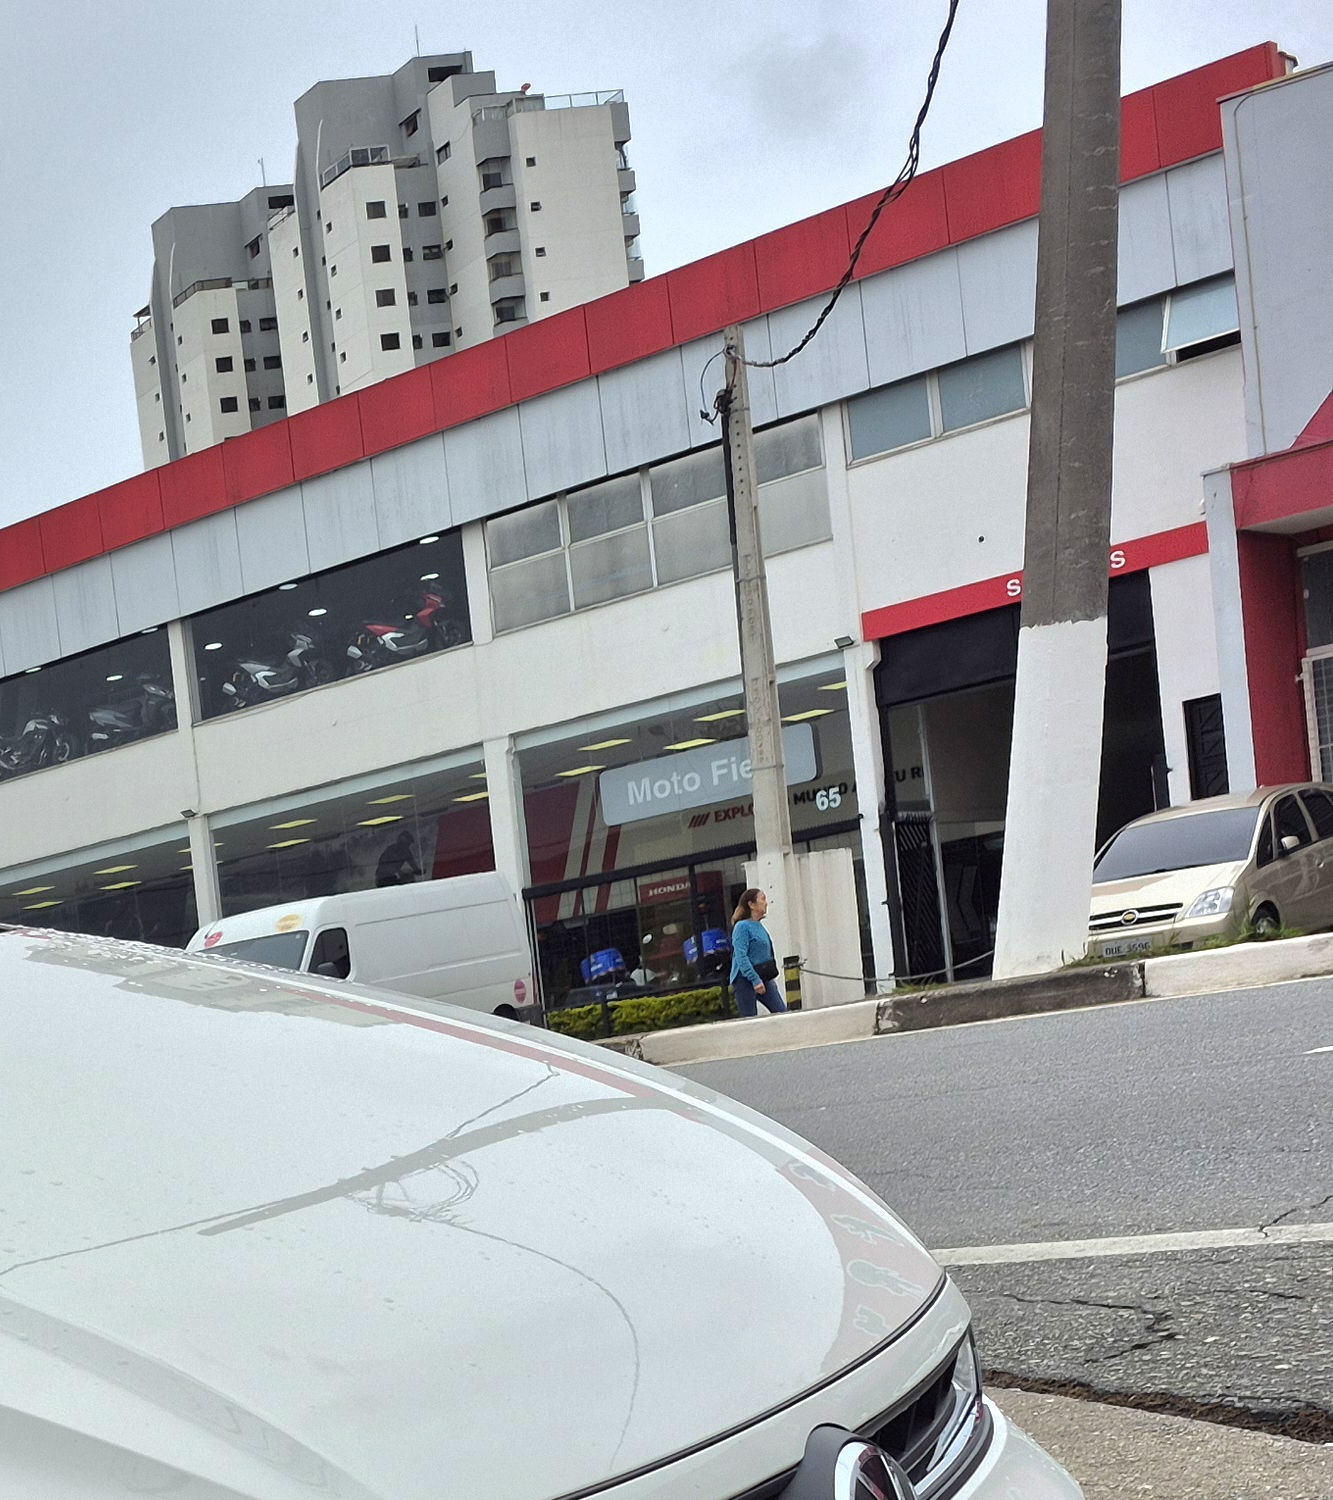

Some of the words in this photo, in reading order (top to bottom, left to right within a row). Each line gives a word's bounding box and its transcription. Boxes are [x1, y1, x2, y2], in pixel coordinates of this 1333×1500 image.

[626, 769, 702, 806] Moto
[710, 756, 755, 787] Fie
[815, 786, 842, 812] 65
[648, 881, 691, 897] HONDA
